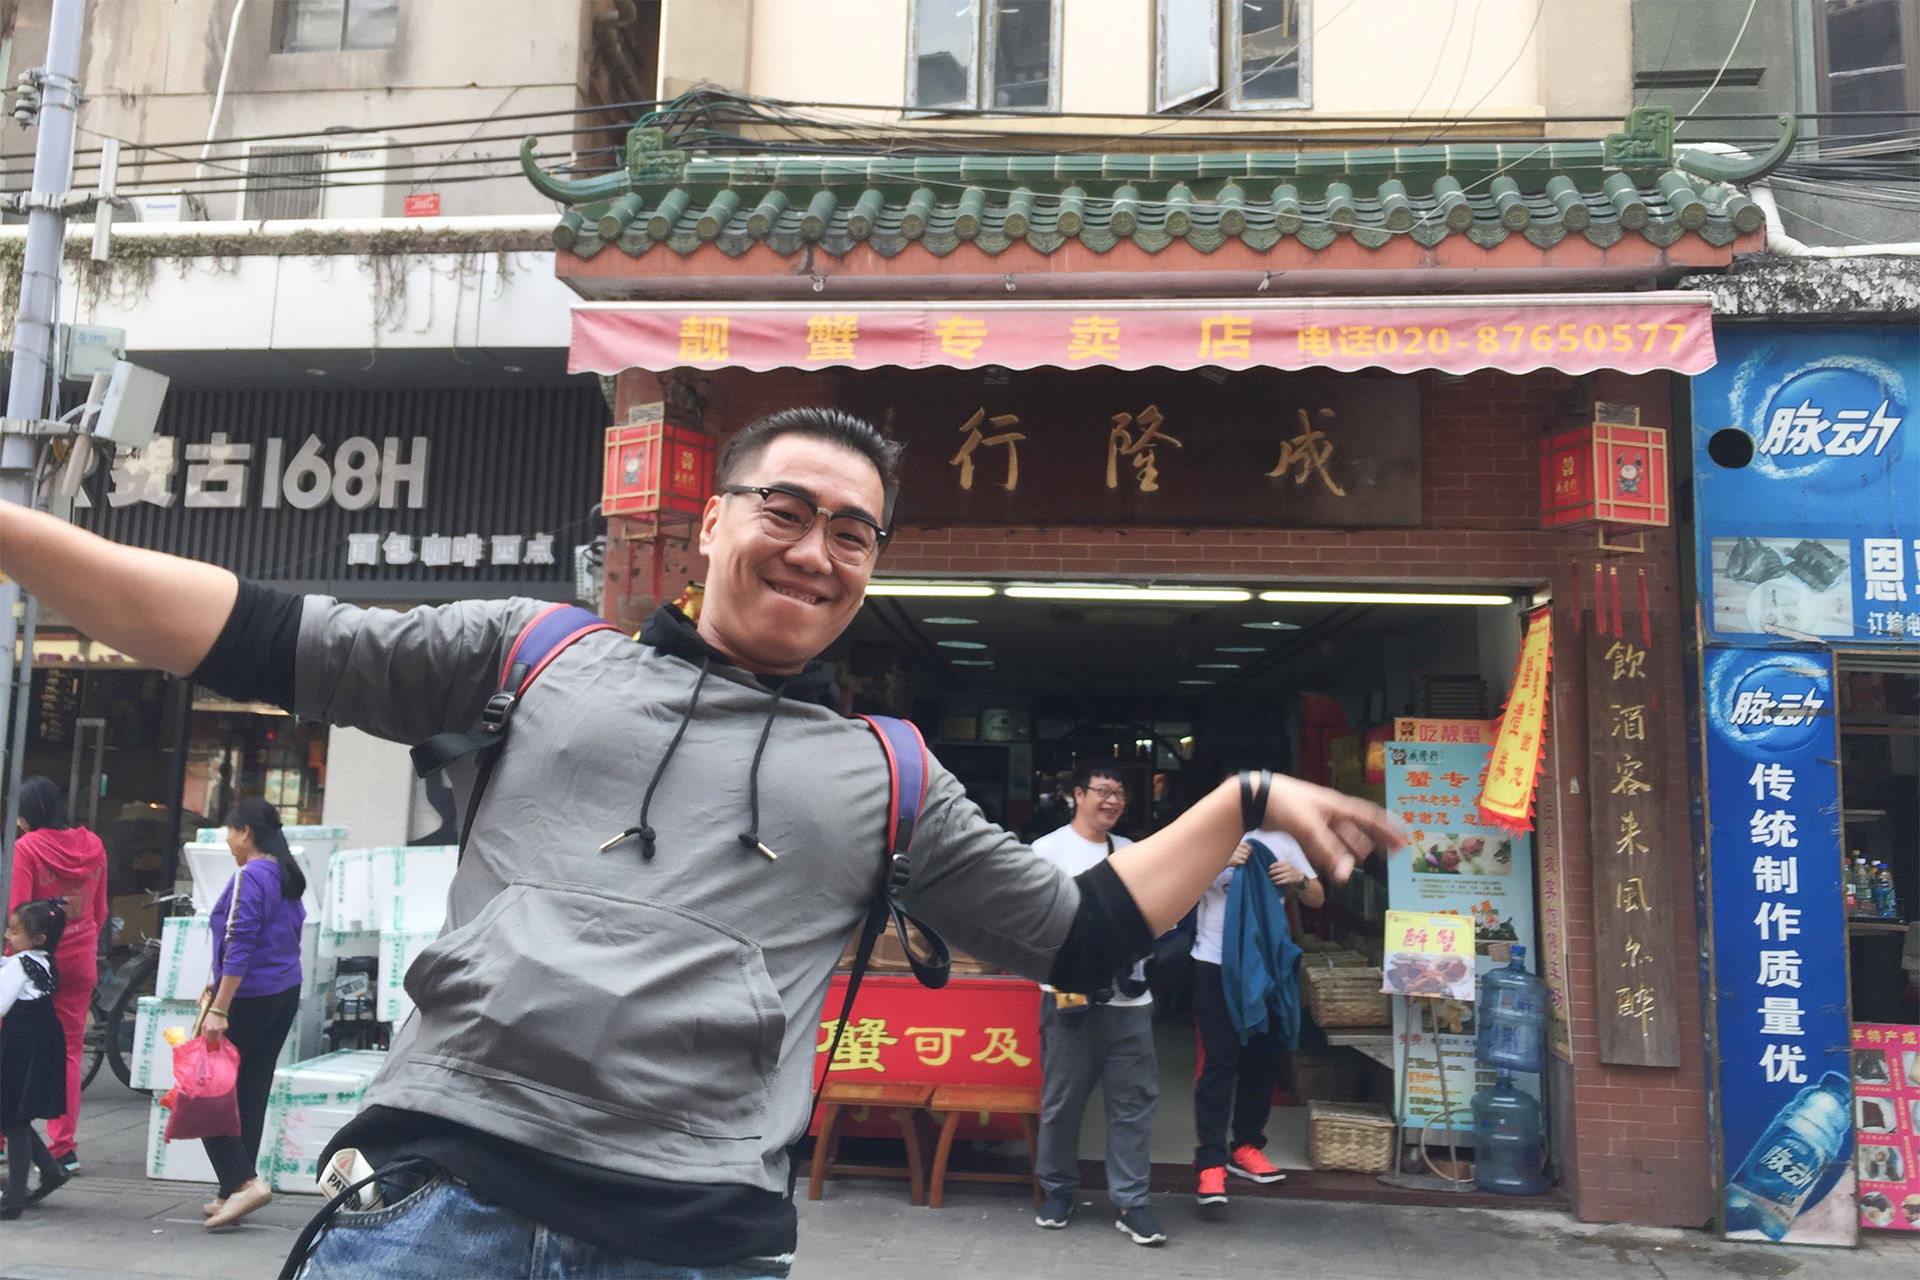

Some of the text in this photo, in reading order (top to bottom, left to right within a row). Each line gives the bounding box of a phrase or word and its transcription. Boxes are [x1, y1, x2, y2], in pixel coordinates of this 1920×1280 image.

[678, 315, 1687, 362] 靓蟹专卖店 电话020-87650577
[1759, 398, 1903, 456] 脉动
[347, 531, 555, 567] 面包 咖啡 西点
[1863, 538, 1920, 602] 恩
[1729, 685, 1825, 727] 脉动
[1749, 762, 1809, 1084] 传统制作质量优
[816, 1017, 1033, 1074] 蟹可及
